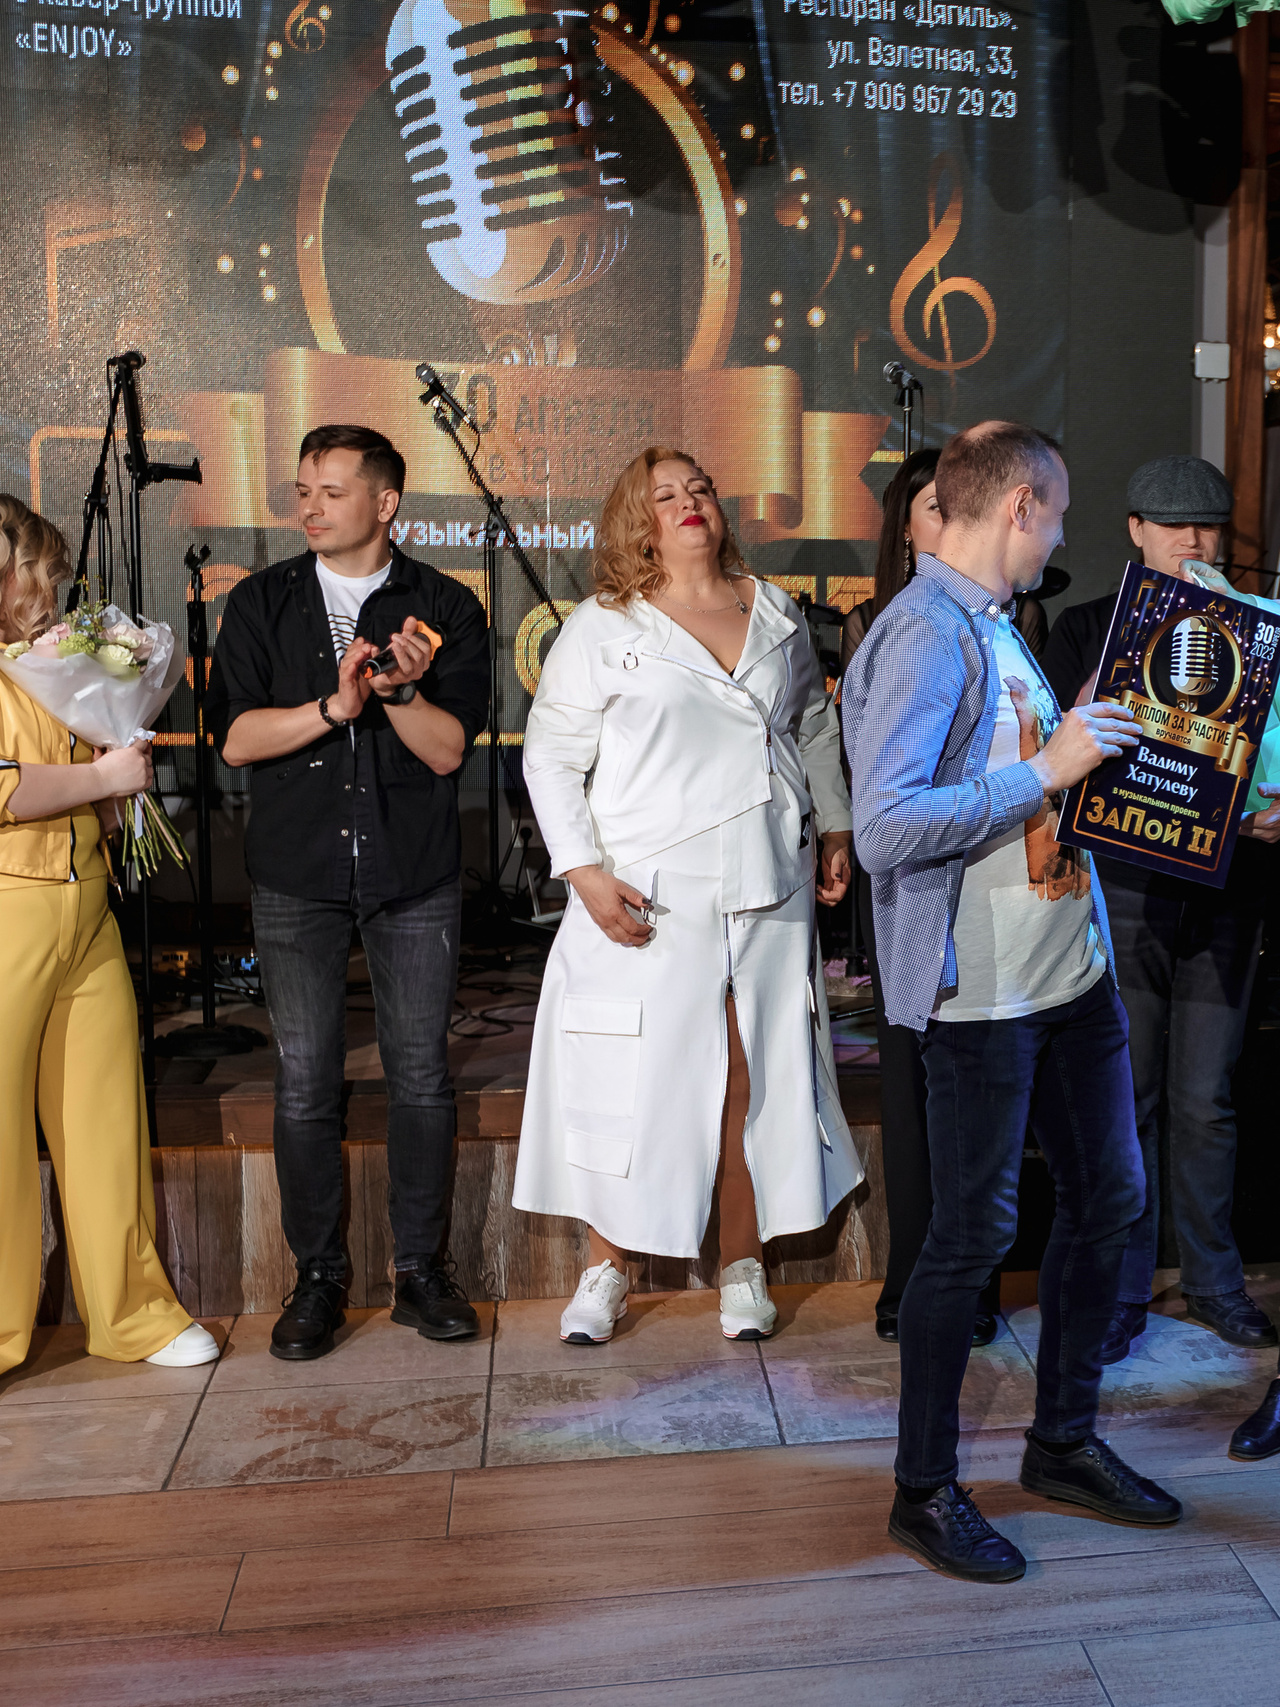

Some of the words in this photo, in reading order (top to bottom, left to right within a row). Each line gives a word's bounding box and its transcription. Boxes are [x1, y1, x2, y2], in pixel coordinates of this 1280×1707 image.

[16, 22, 132, 59] «ENJOY»
[826, 39, 861, 68] ул.
[868, 36, 980, 77] Взлетная,
[986, 45, 1017, 79] 33,
[778, 81, 824, 106] тел.
[832, 81, 857, 107] +7
[864, 80, 906, 111] 906
[913, 84, 952, 113] 967
[957, 87, 985, 116] 29
[990, 90, 1017, 118] 29
[389, 520, 595, 549] УЗЫКЬНЫЙ
[1254, 621, 1275, 645] 30
[1250, 641, 1275, 661] 2023
[1156, 728, 1192, 746] вручается
[1171, 715, 1185, 731] ЗА
[1186, 720, 1232, 746] УЧАСТИЕ
[1137, 745, 1199, 782] Вадиму
[1125, 763, 1199, 803] Хатулеву
[1112, 787, 1119, 795] в
[1119, 788, 1170, 810] музыкальном
[1170, 803, 1200, 819] проекте
